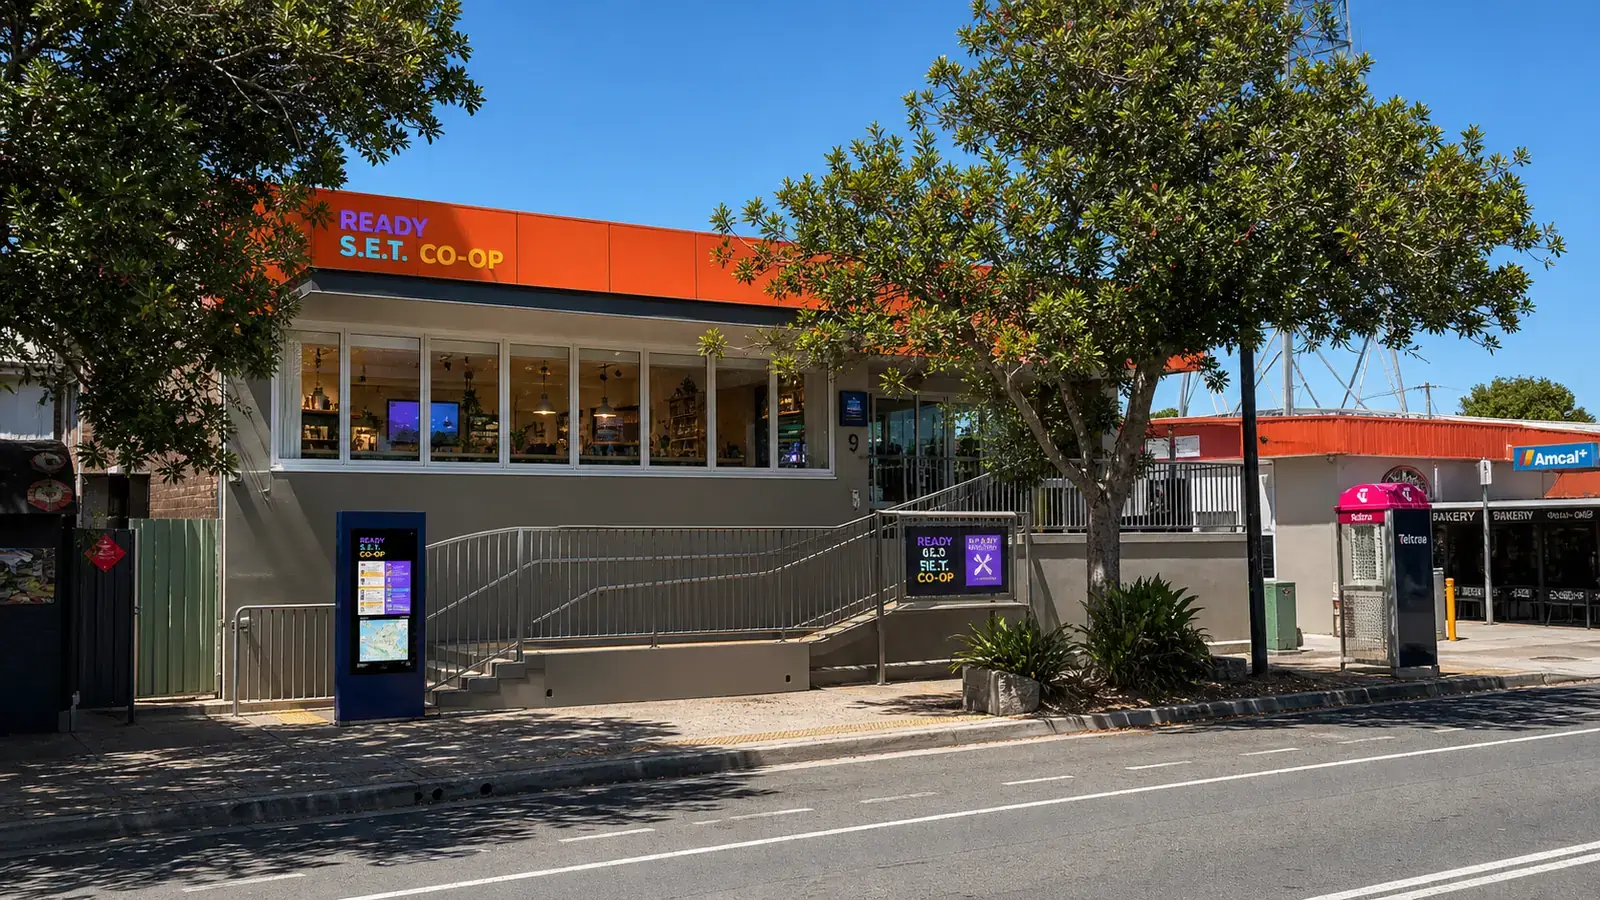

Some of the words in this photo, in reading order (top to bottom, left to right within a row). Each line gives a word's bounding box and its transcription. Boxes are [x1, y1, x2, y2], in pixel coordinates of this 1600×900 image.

[340, 209, 429, 237] READY
[340, 235, 408, 262] S.E.T.
[419, 243, 504, 270] CO-OP
[848, 433, 859, 453] 9
[1432, 511, 1475, 522] BAKERY
[917, 536, 953, 546] READY
[917, 572, 955, 583] CO-OP
